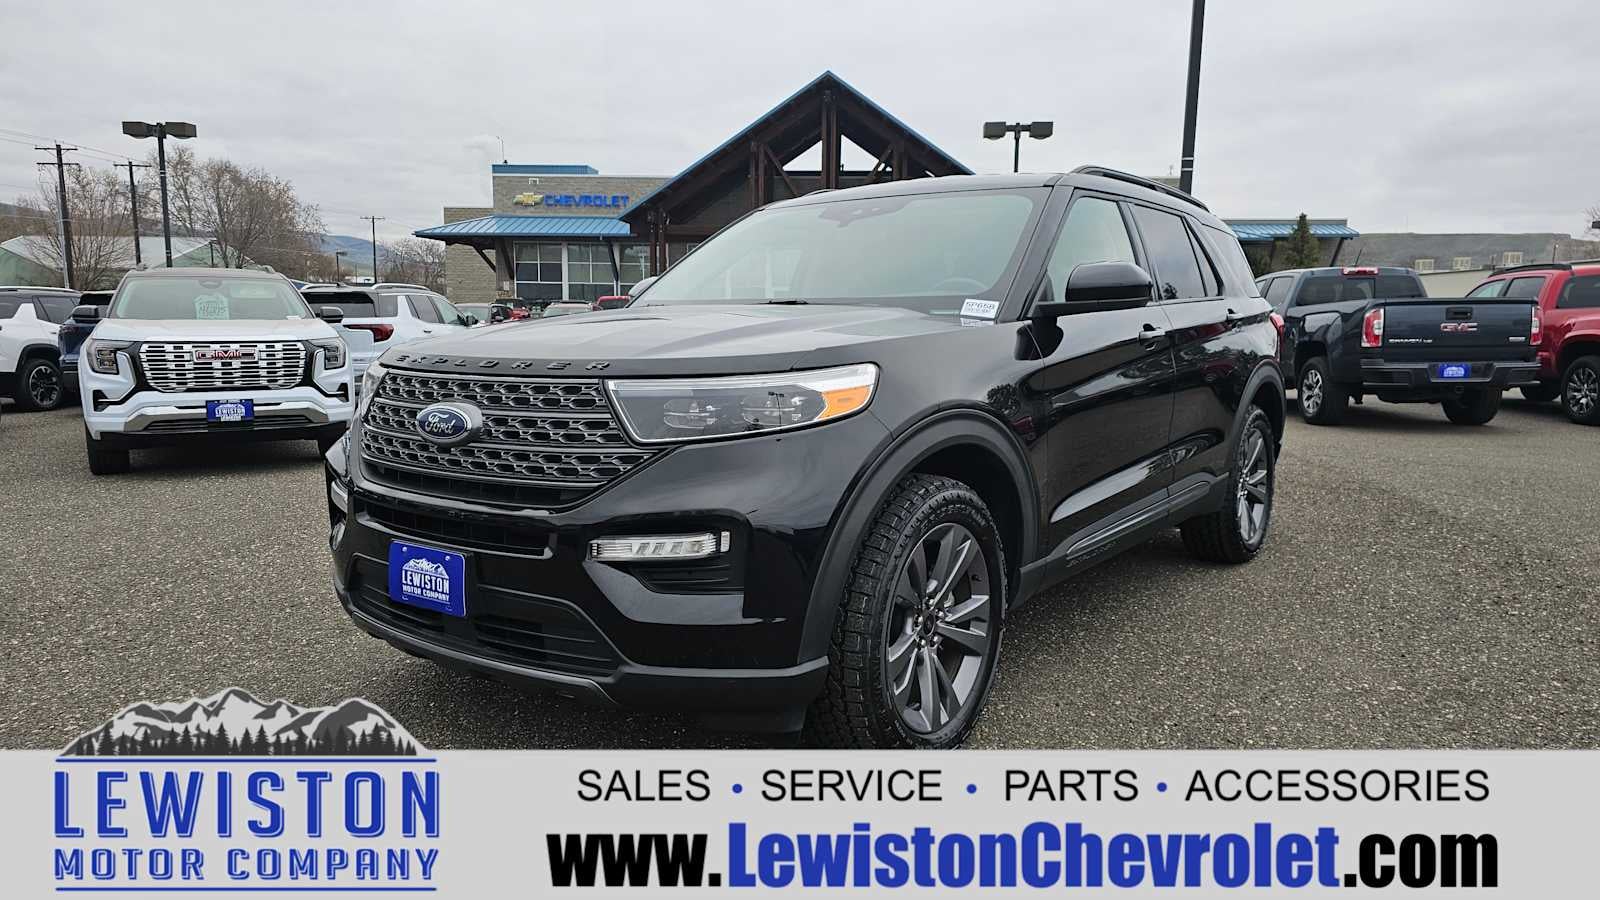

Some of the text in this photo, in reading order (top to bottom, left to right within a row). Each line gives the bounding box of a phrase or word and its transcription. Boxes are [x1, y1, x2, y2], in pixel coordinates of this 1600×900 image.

[544, 194, 630, 207] CHEVROLET
[1440, 322, 1478, 332] GMC
[196, 349, 255, 361] GMC
[396, 354, 611, 371] EXPLORER
[424, 411, 456, 434] Ford
[402, 569, 450, 594] LEWISTON
[402, 584, 450, 602] MOTOR COMPANY
